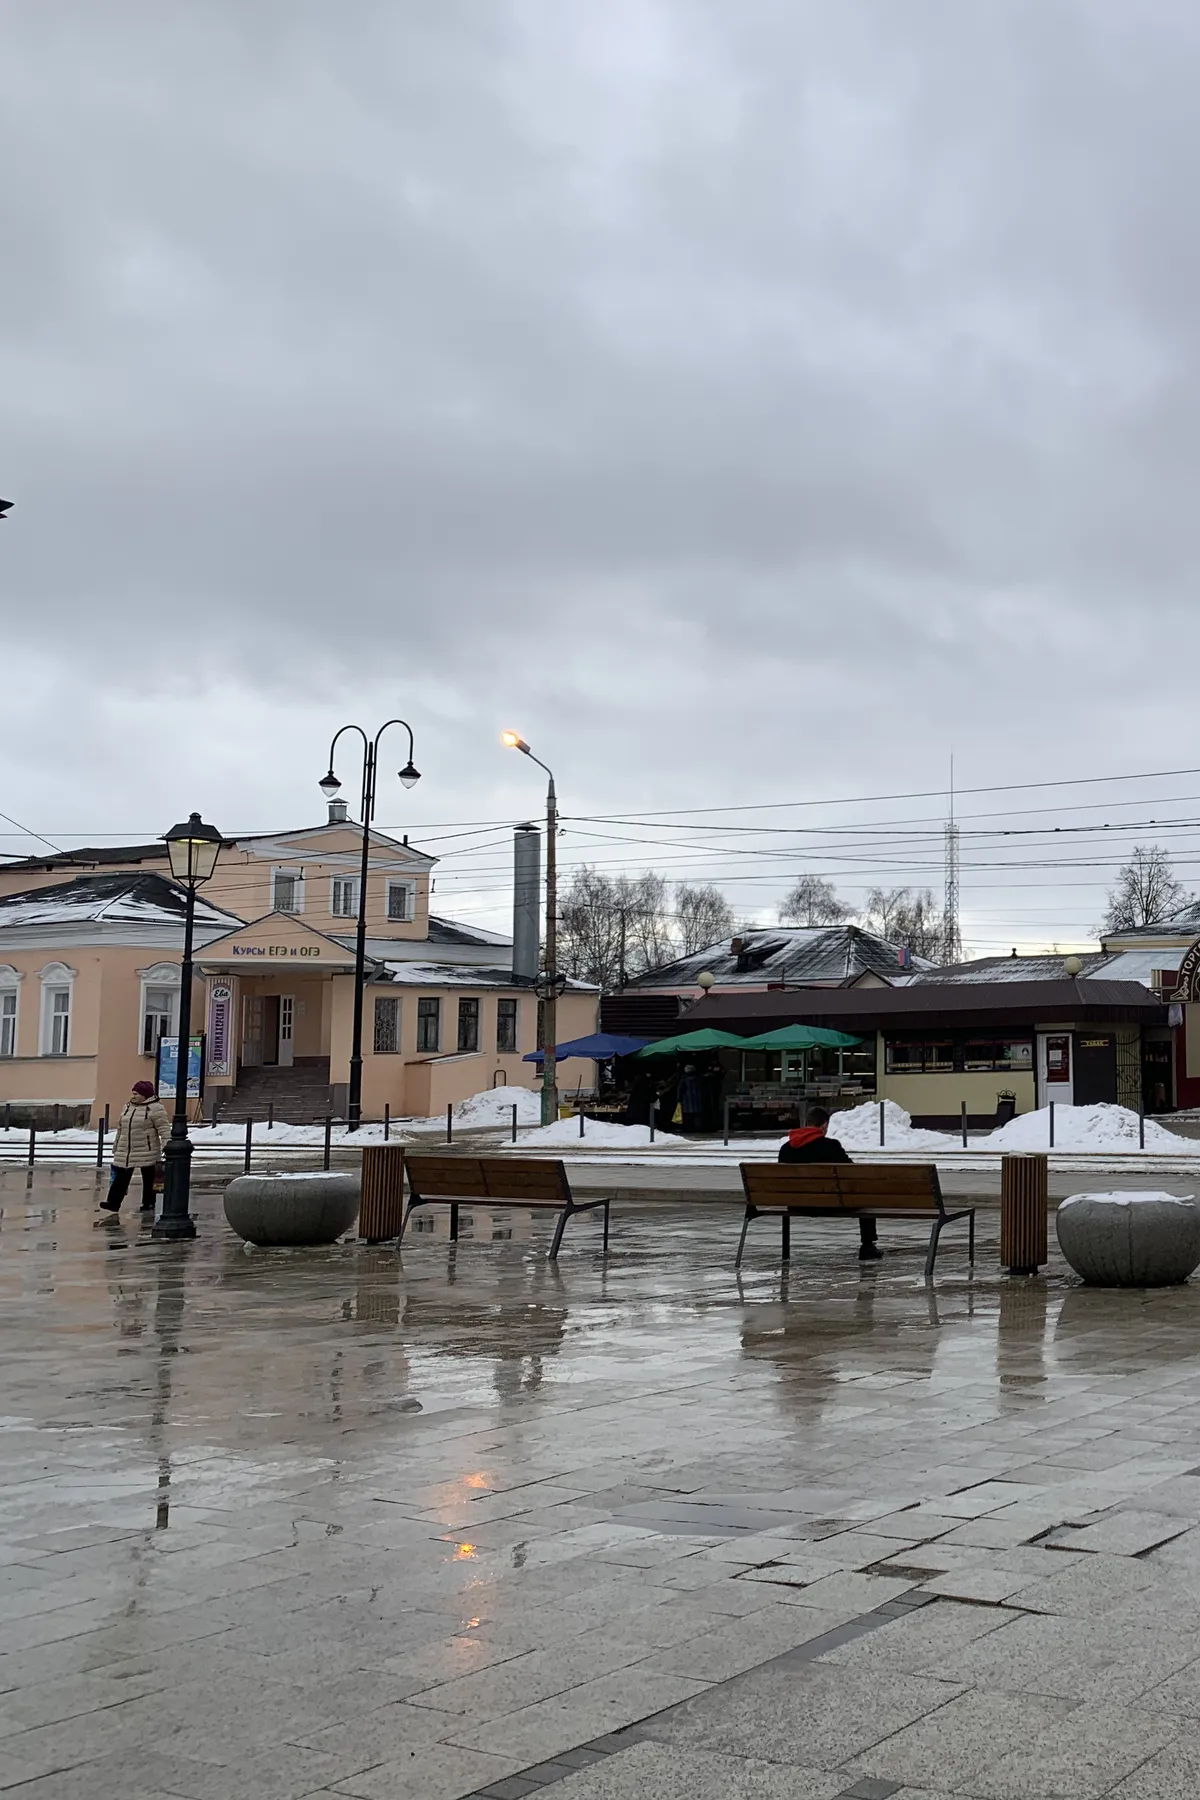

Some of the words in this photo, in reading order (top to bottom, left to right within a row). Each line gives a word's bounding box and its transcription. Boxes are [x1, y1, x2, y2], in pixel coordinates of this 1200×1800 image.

[268, 945, 288, 956] ЕГЭ
[300, 946, 321, 957] ОГЭ
[213, 989, 229, 998] Ева
[213, 1004, 225, 1061] ПАРИКМАХЕРСКАЯ
